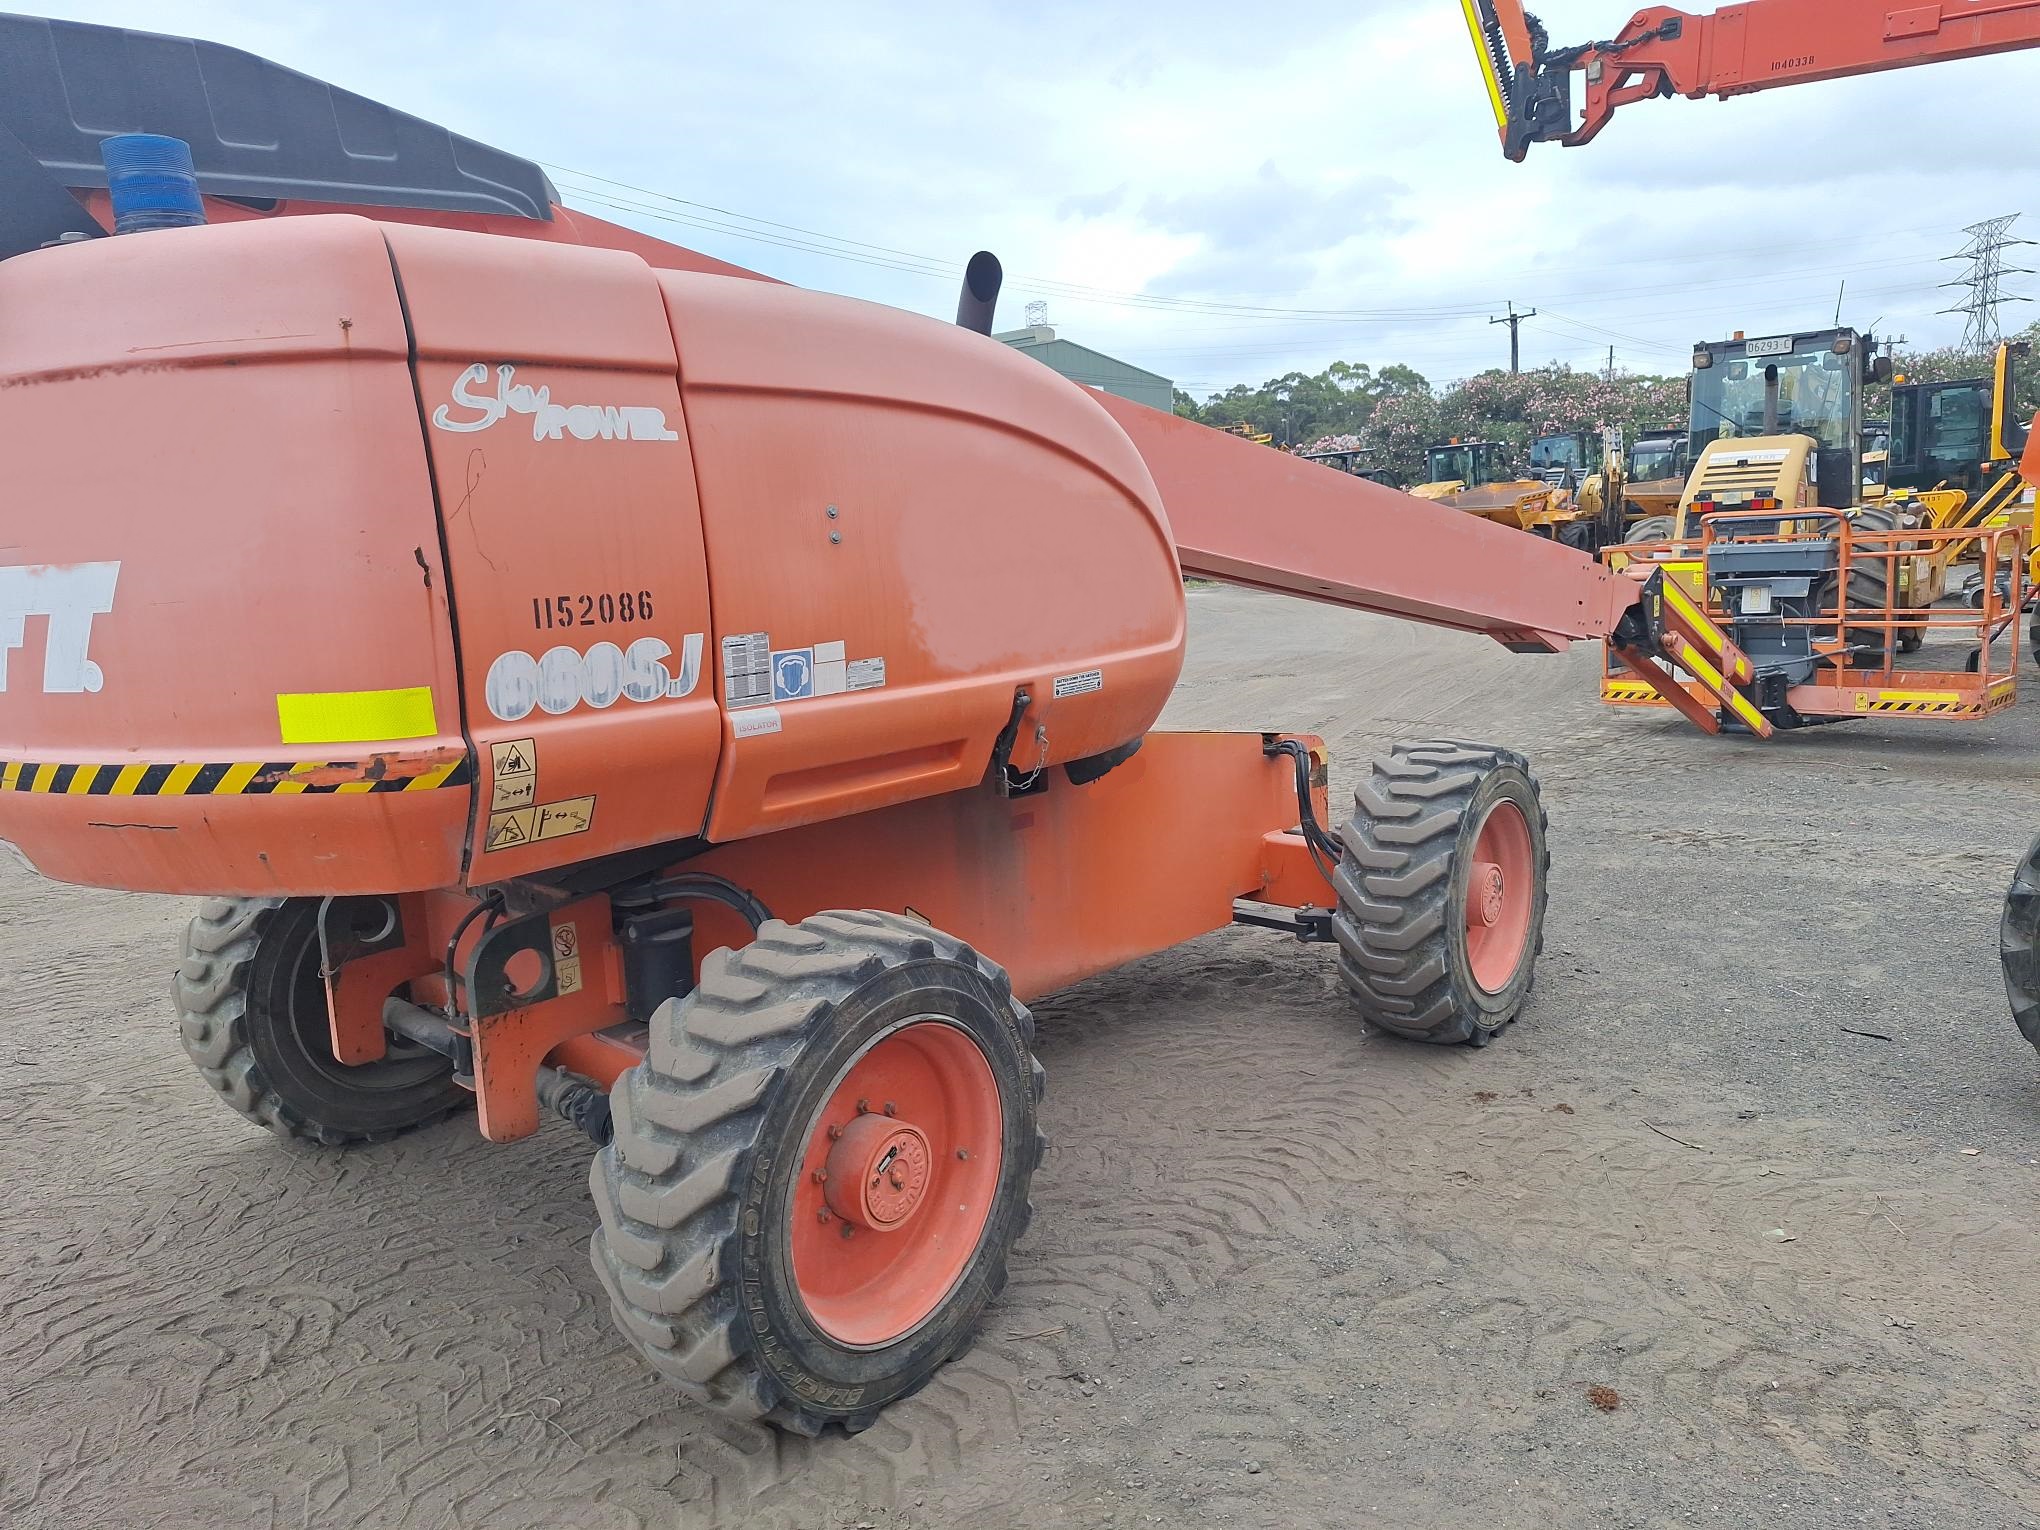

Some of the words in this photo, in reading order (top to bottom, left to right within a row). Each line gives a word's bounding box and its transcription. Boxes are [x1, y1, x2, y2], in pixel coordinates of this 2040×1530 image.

[1771, 55, 1815, 71] 1040338
[532, 590, 654, 629] 1152086
[739, 720, 778, 732] ISOLATOR
